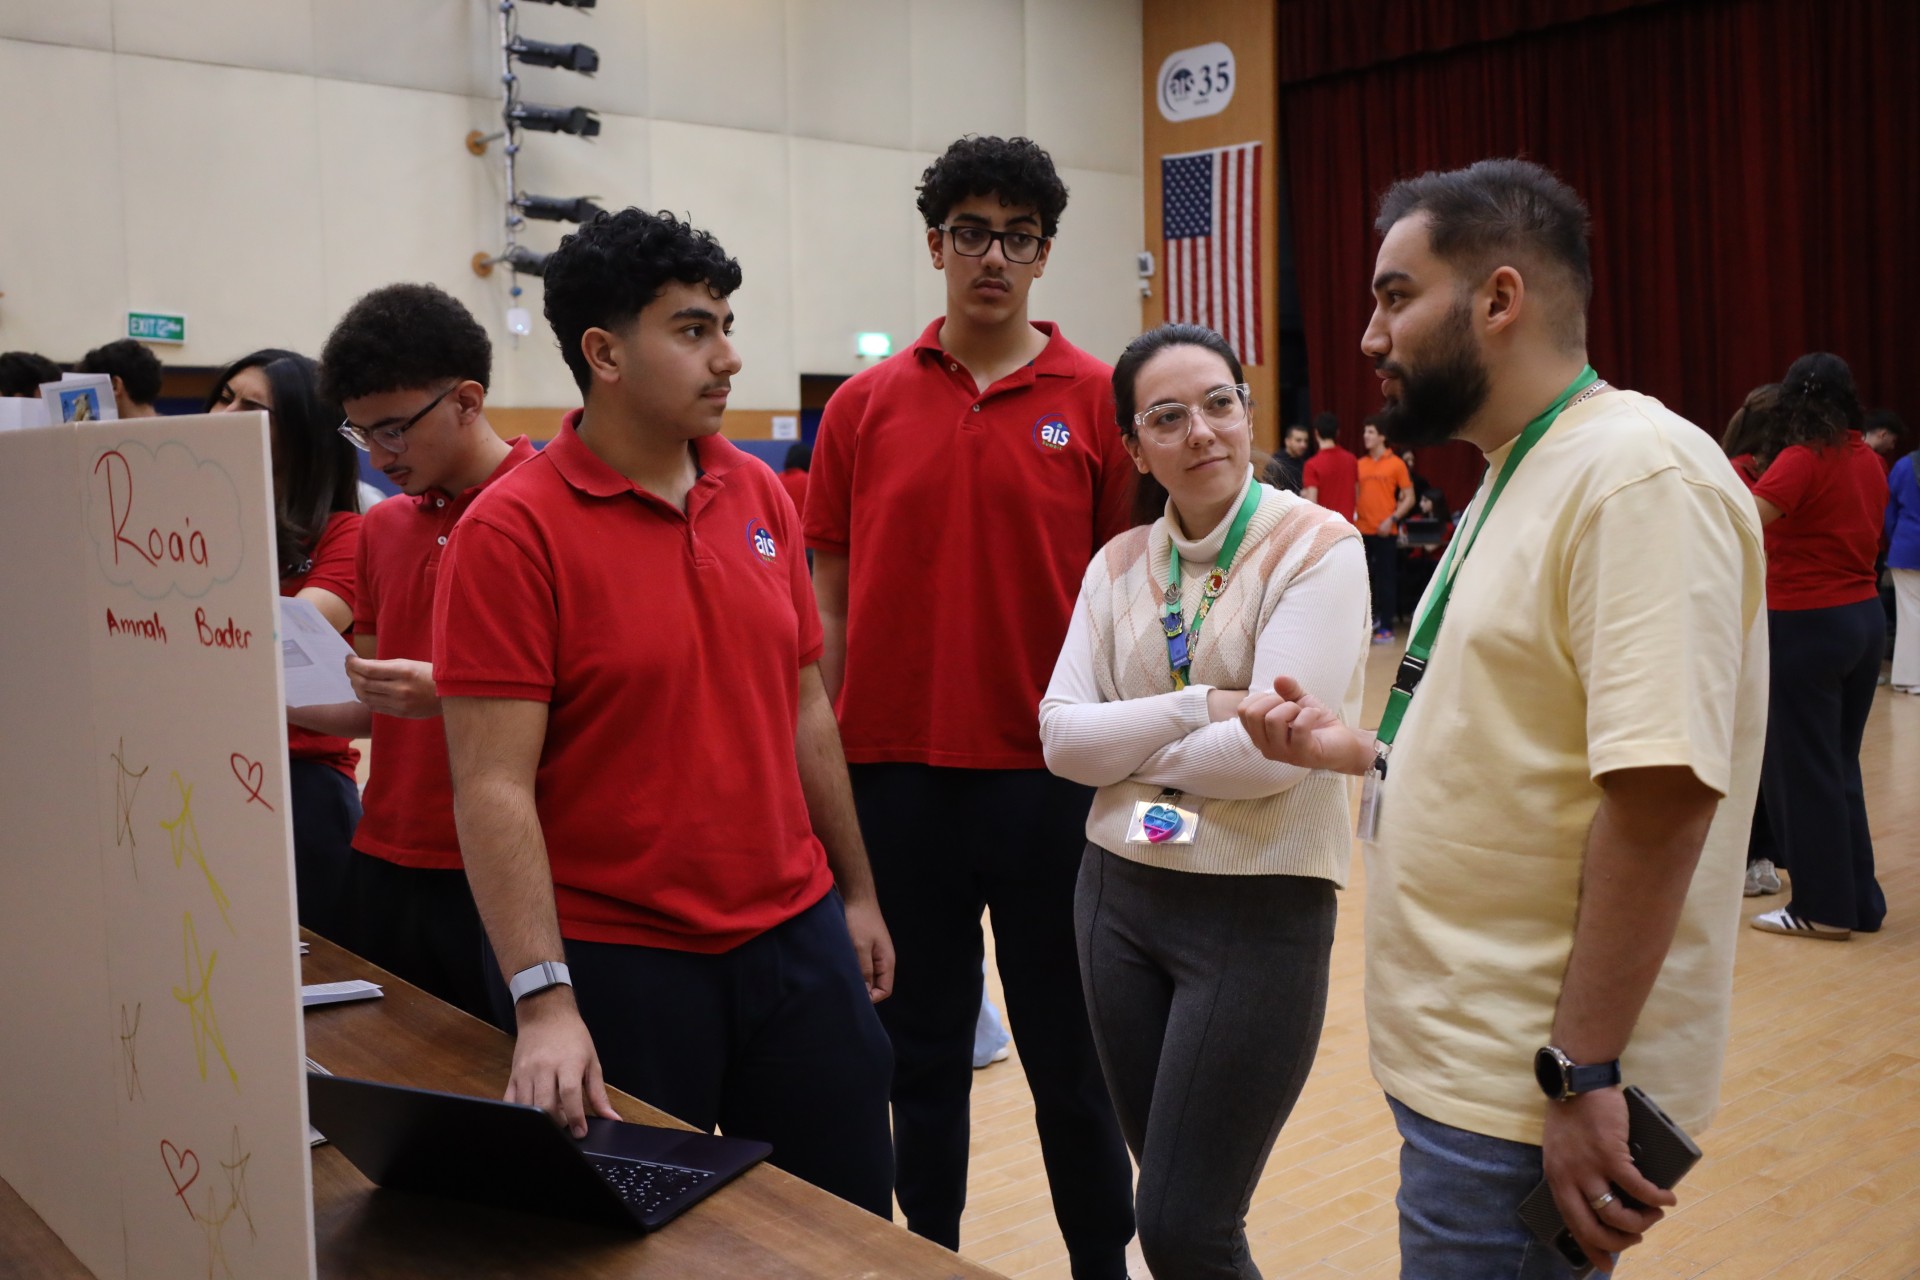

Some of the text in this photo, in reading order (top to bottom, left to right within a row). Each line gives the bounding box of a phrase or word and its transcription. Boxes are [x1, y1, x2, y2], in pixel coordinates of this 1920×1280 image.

[1198, 61, 1230, 96] 35
[130, 317, 156, 335] EXIT
[1041, 423, 1070, 446] ais
[754, 529, 776, 557] ais
[106, 606, 252, 649] Amnah Bader
